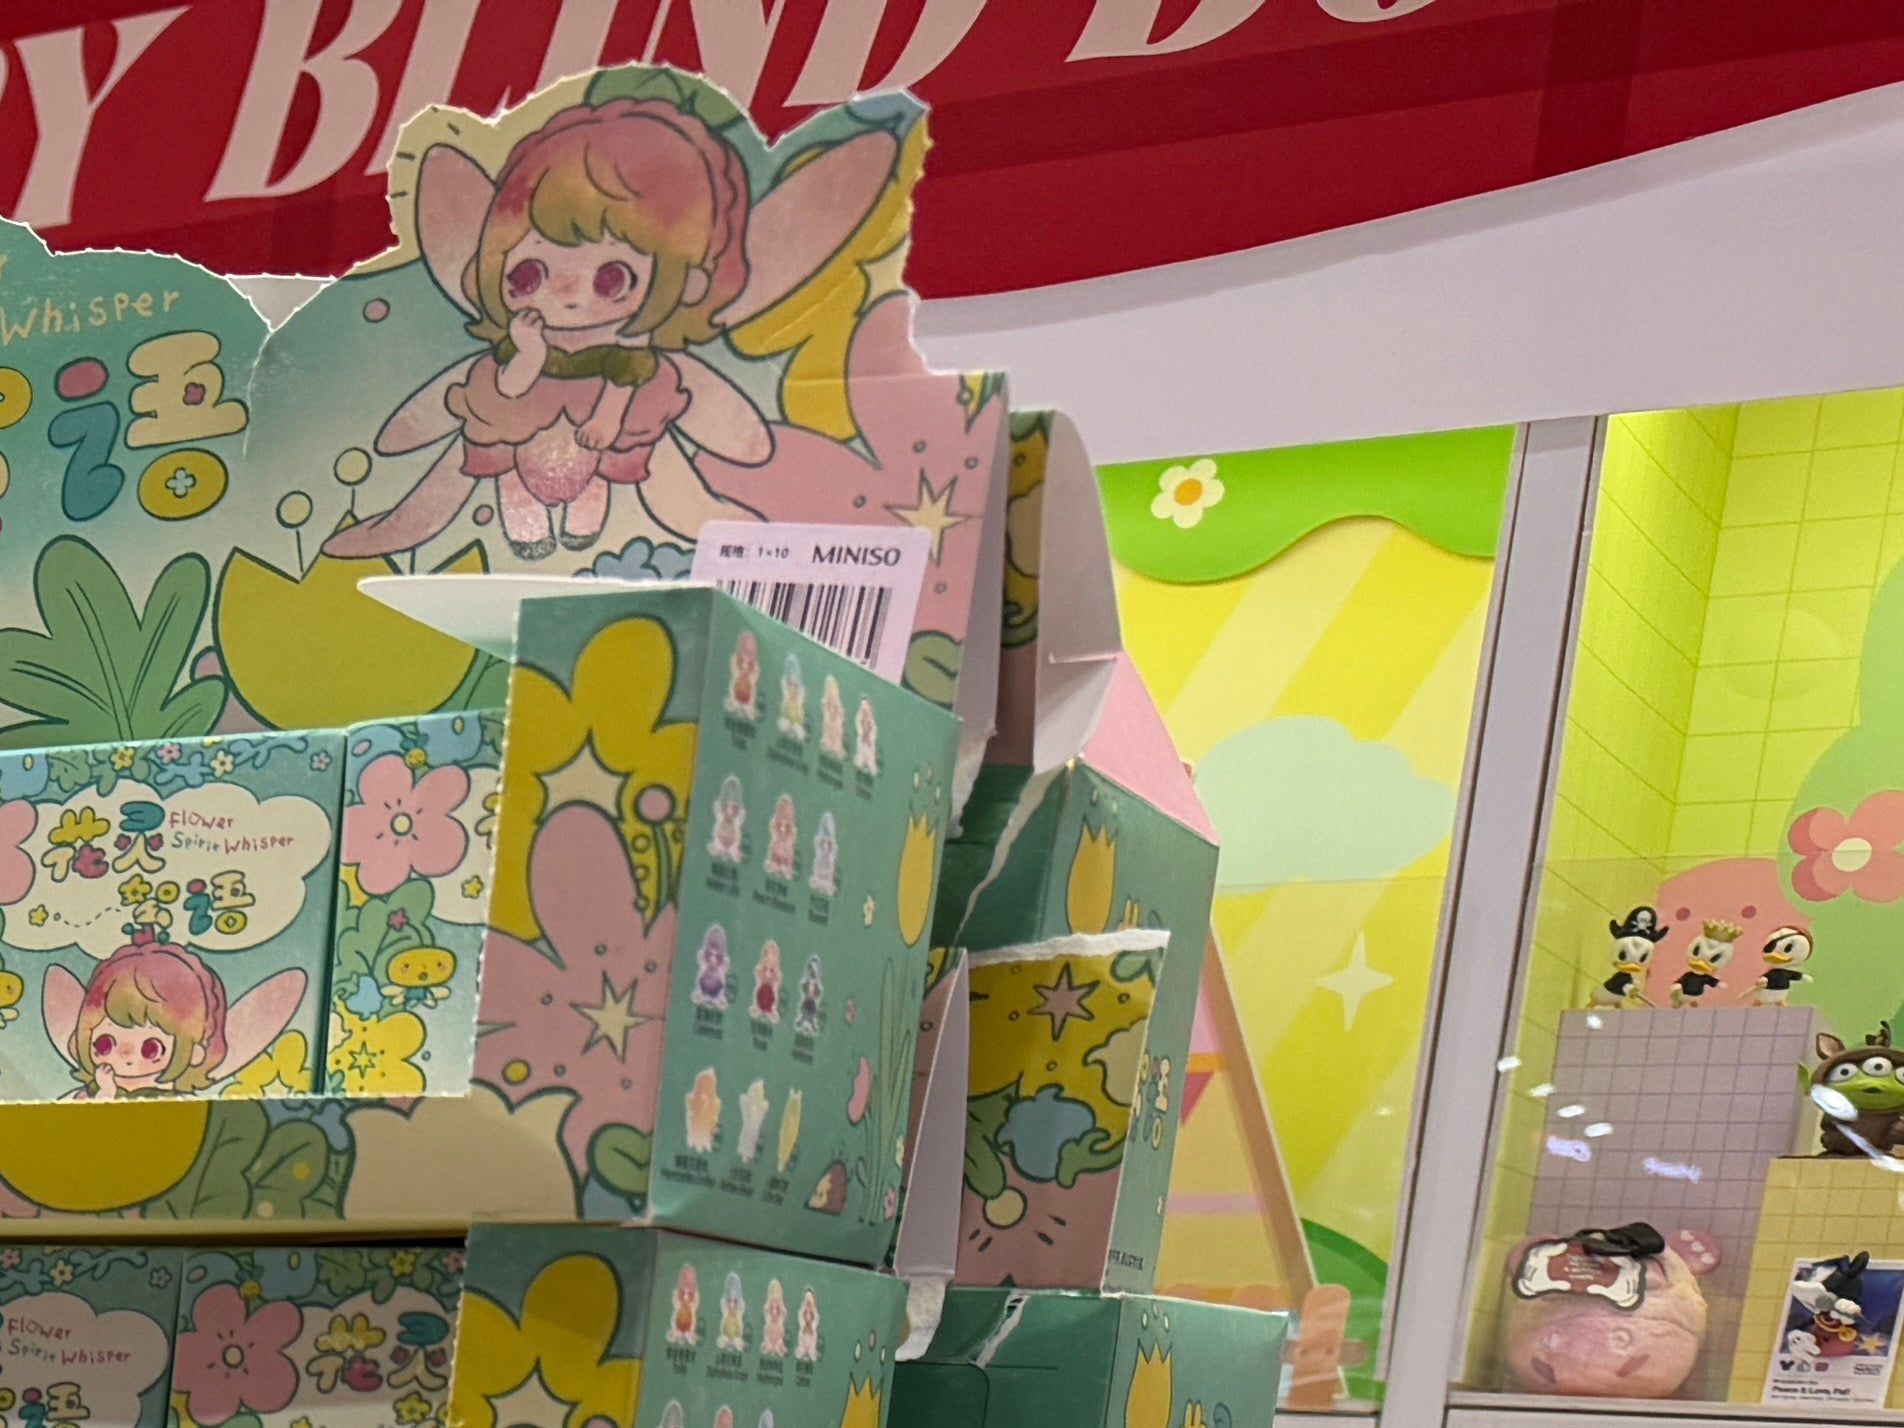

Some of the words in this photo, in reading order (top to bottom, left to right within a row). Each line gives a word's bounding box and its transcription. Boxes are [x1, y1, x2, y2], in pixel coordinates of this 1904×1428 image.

[811, 543, 902, 568] MINISO
[6, 1315, 73, 1341] Flower
[7, 1338, 58, 1364] Spirit
[59, 1344, 132, 1367] Whisper
